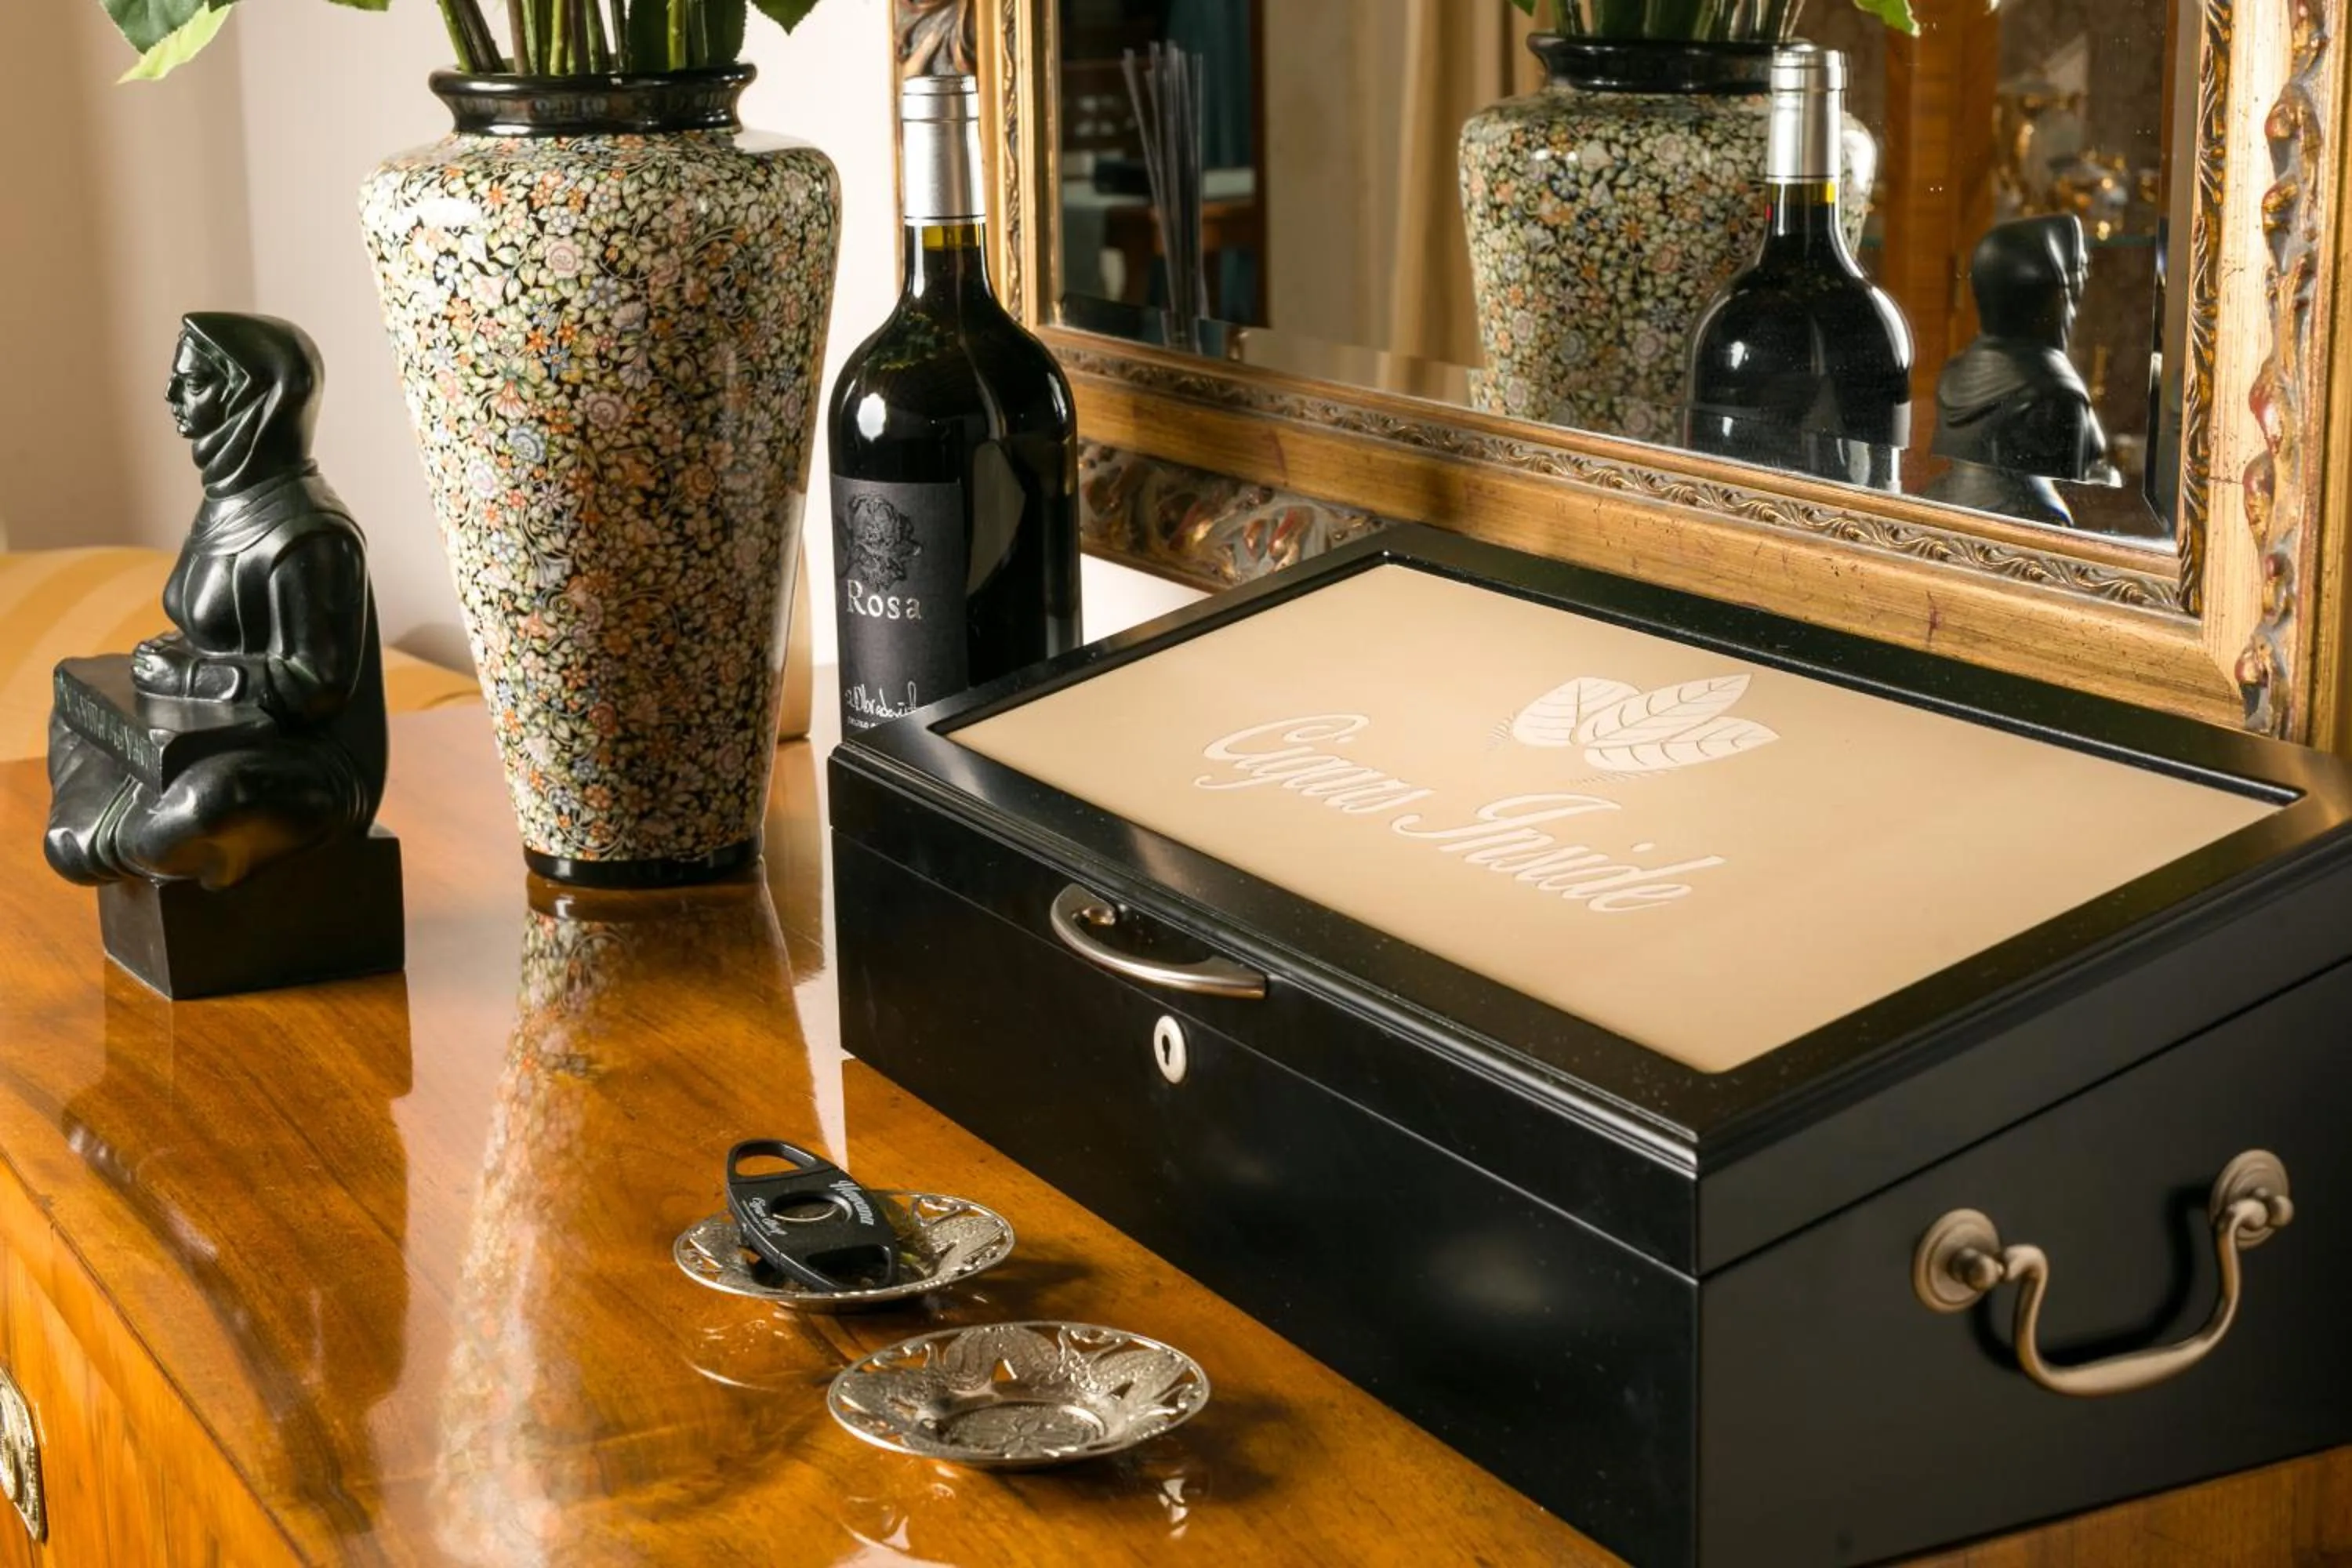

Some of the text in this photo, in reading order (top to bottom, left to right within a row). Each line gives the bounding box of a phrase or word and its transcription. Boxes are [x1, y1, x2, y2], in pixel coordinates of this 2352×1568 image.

[846, 579, 922, 619] Rosa
[1192, 713, 1726, 913] Cigars Inside
